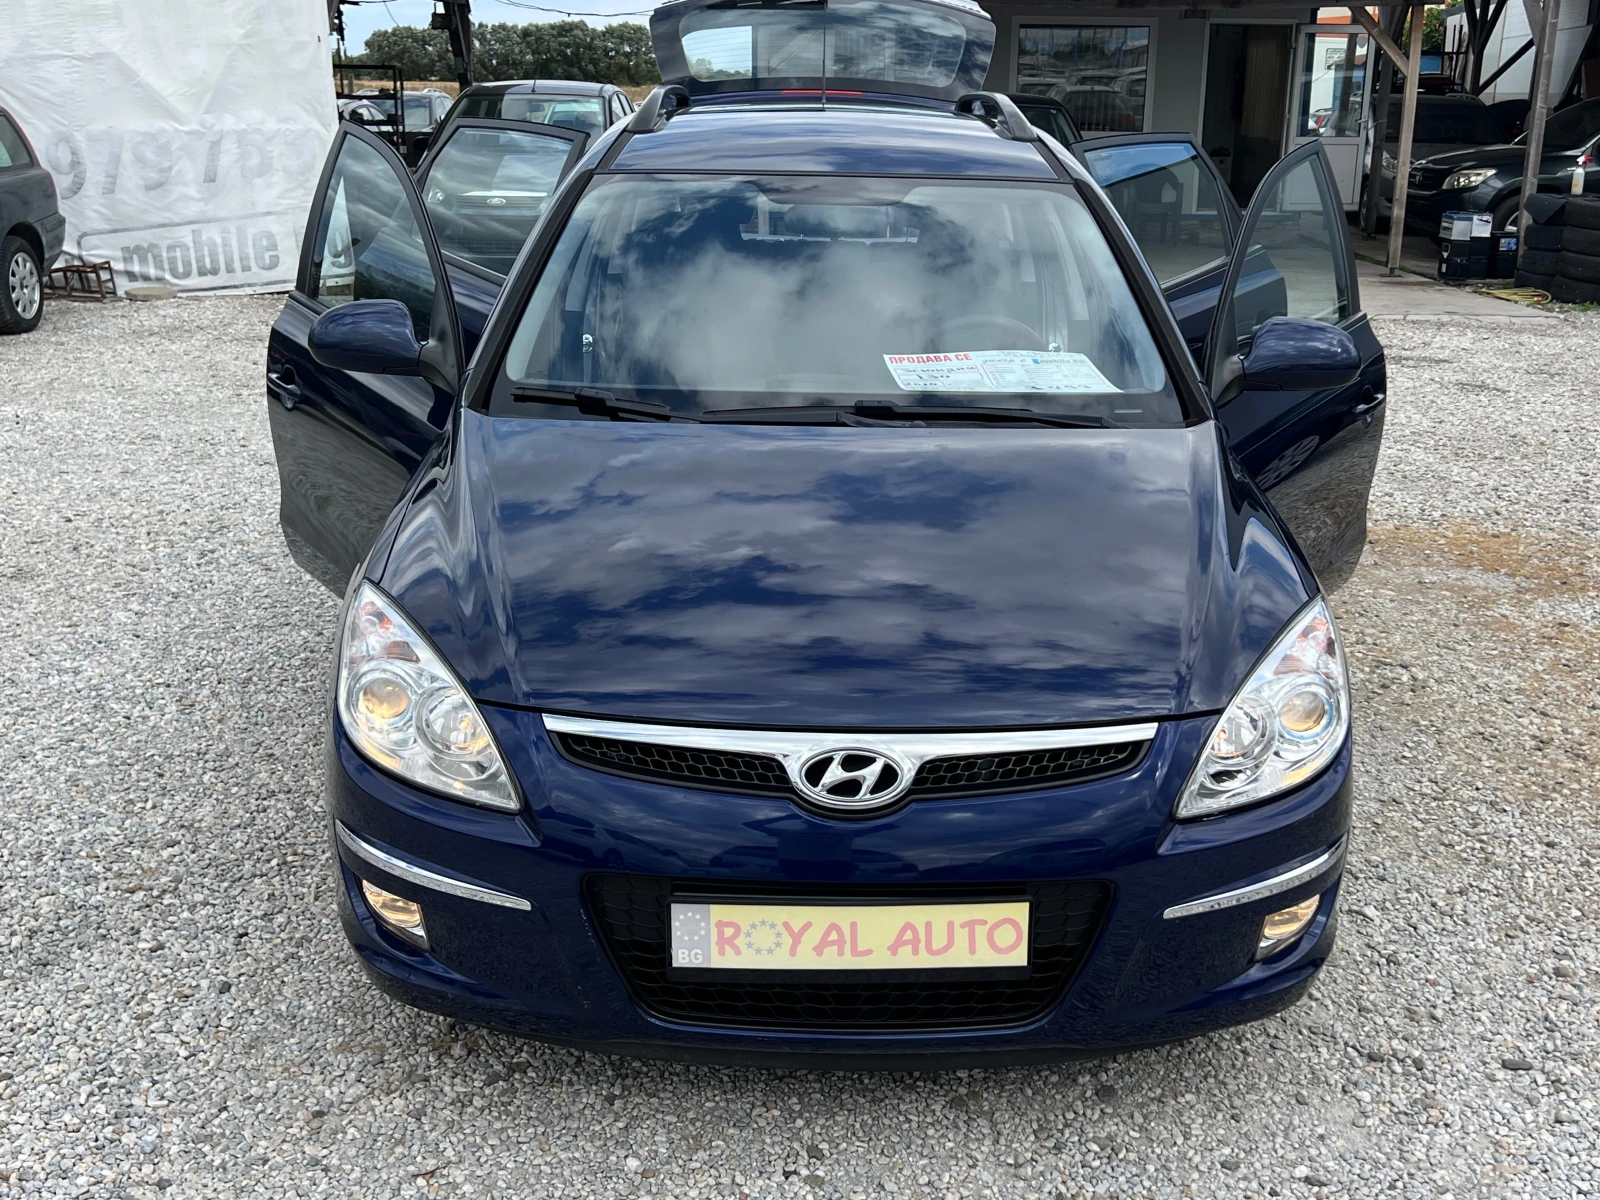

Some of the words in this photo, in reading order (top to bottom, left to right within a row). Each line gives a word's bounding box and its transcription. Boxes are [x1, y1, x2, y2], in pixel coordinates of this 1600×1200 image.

[121, 226, 280, 282] mobile
[888, 354, 952, 364] ПРОДАВА
[954, 353, 973, 361] СЕ
[714, 918, 874, 958] ROYAL
[887, 917, 1024, 957] AUTO
[677, 947, 703, 964] BG
